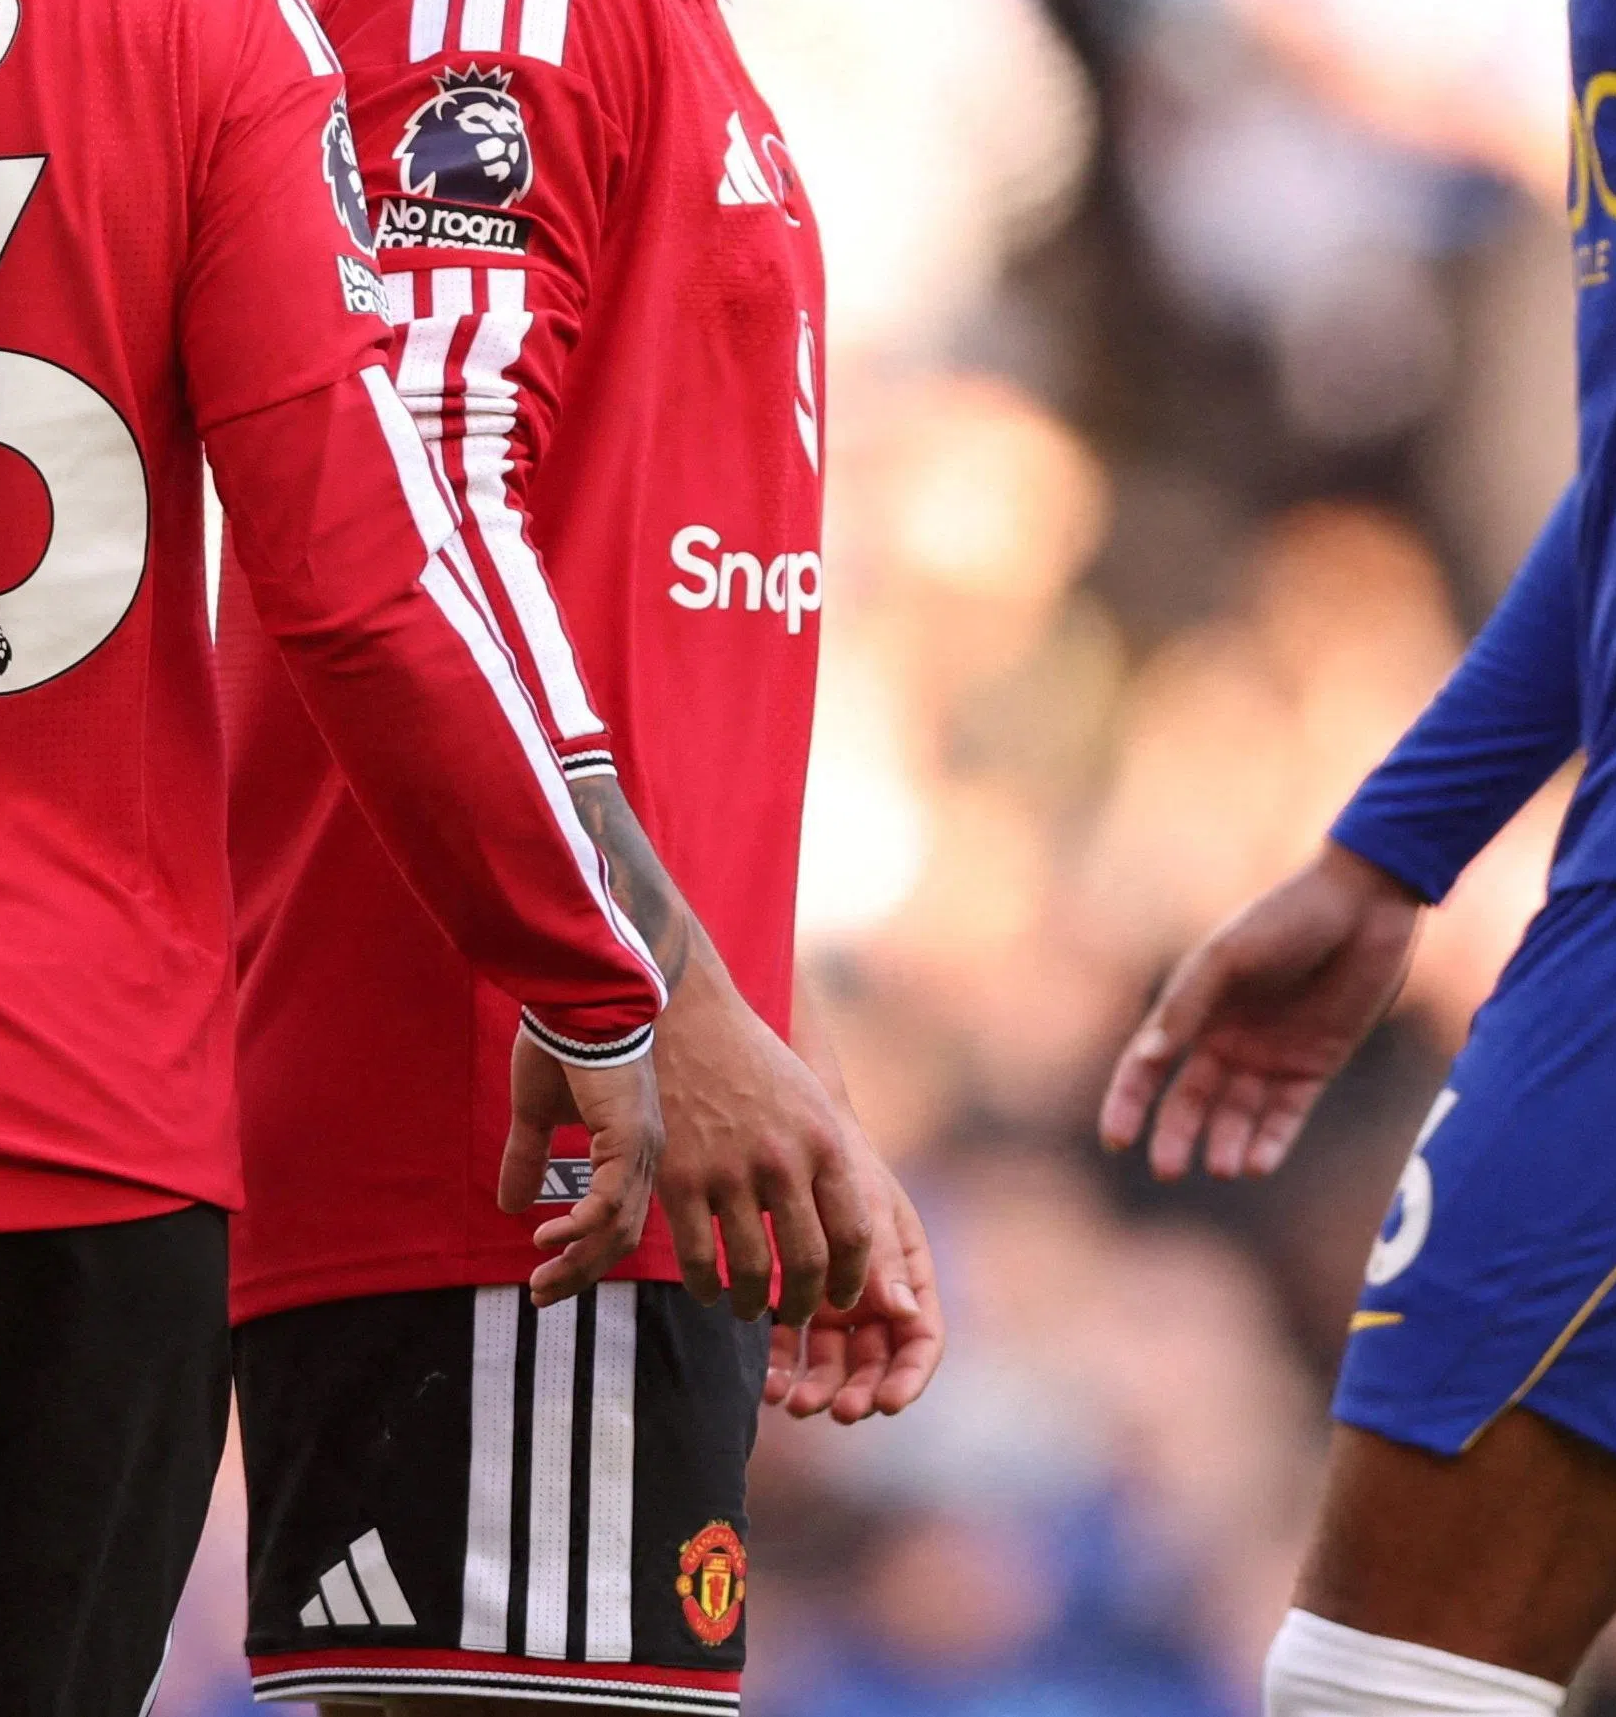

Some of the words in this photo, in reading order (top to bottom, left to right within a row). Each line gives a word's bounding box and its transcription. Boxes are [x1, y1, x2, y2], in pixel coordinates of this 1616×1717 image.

[379, 198, 427, 231] No
[431, 208, 517, 244] room
[668, 524, 823, 635] Snap
